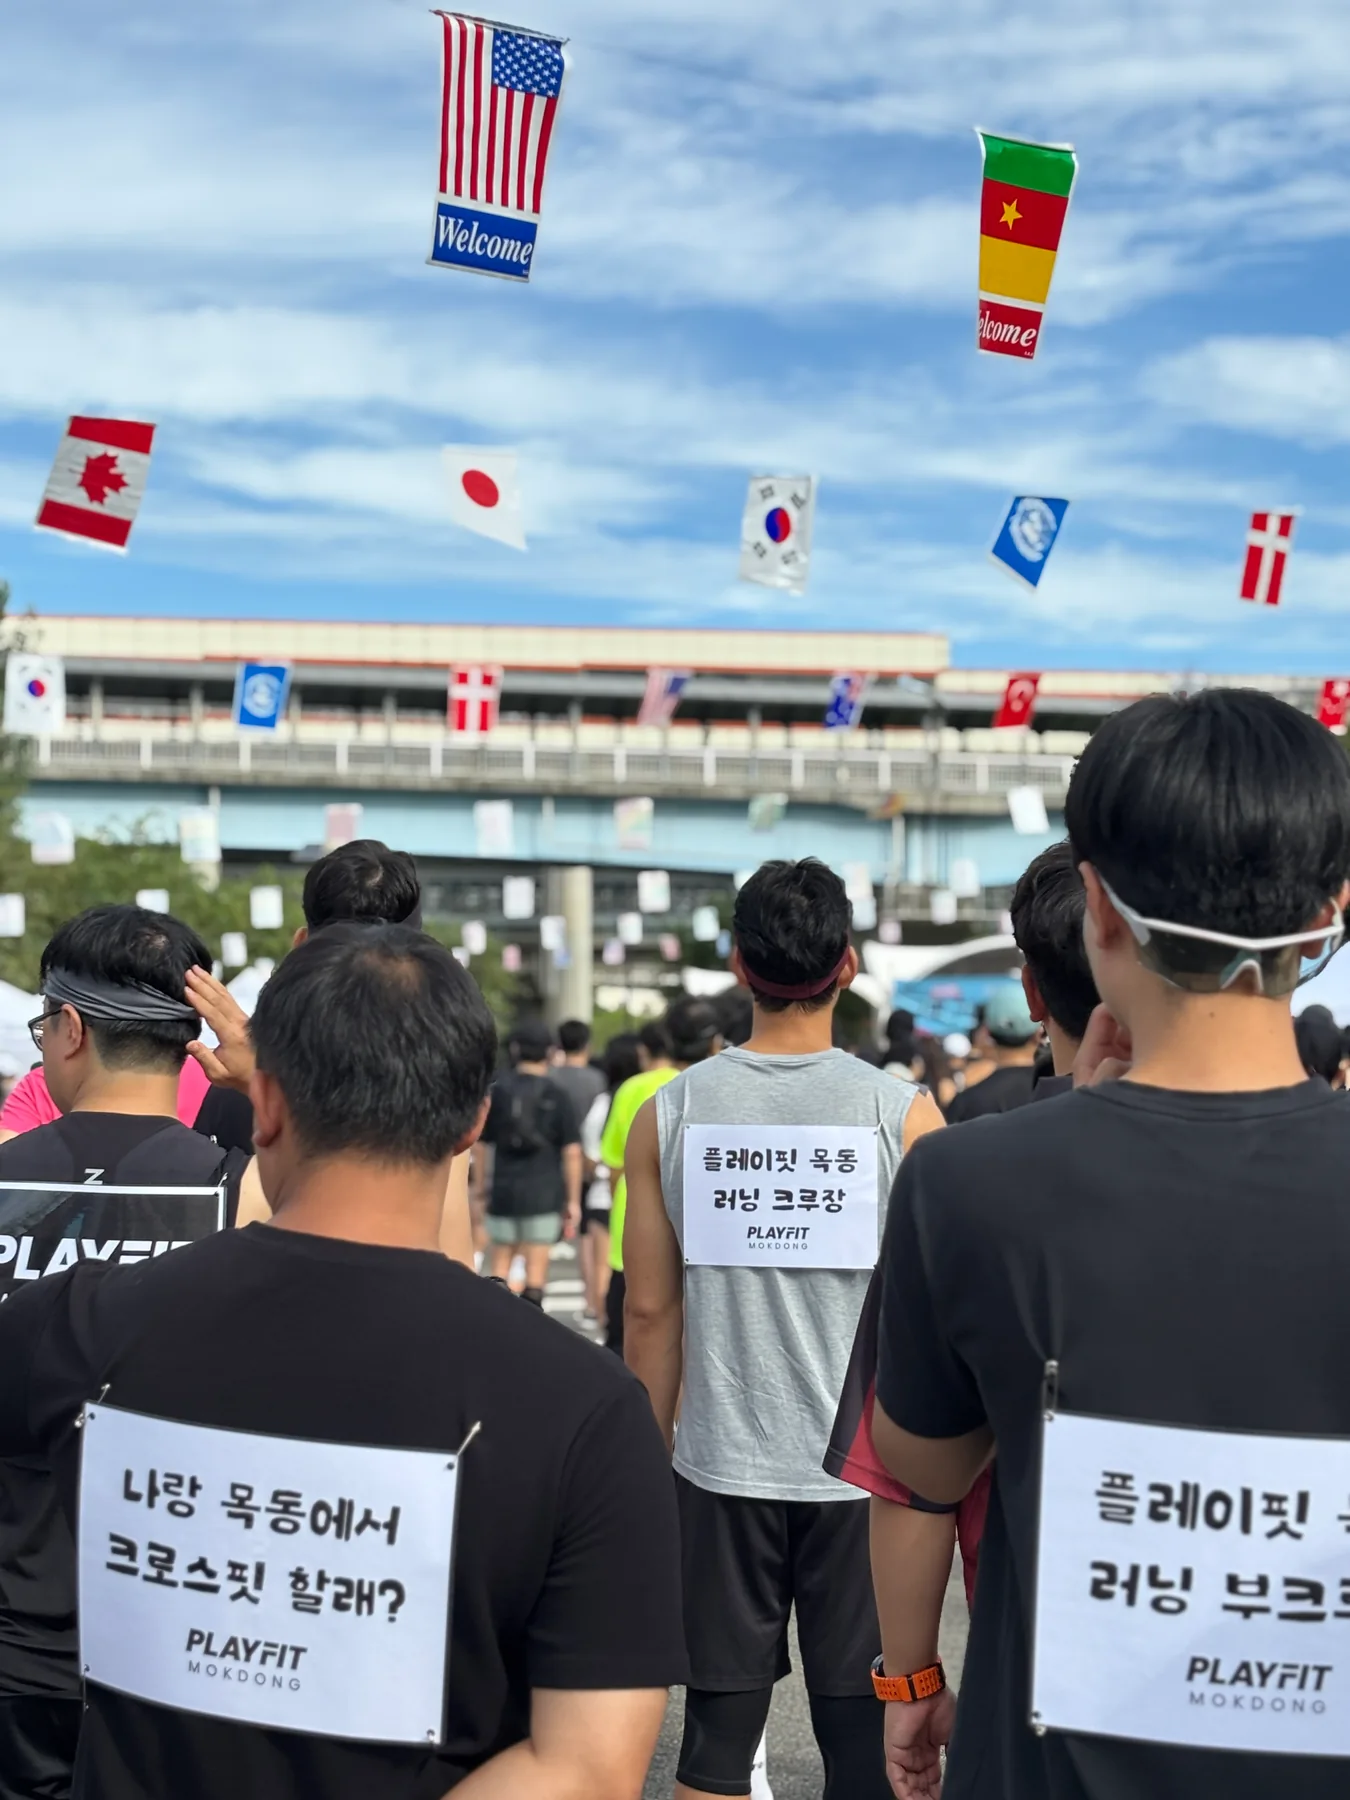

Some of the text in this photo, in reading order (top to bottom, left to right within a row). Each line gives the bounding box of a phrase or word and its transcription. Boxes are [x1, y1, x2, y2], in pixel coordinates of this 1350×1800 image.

[437, 213, 534, 265] Welcome
[979, 309, 1037, 347] elcome
[703, 1147, 858, 1173] 플레이핏 목동
[714, 1188, 846, 1213] 러닝 크루장
[747, 1226, 810, 1240] PLAYFIT
[749, 1242, 808, 1250] MOKDONG
[123, 1468, 401, 1546] 나랑 목동에서
[1094, 1470, 1310, 1541] 플레이핏
[105, 1531, 406, 1623] 크로스핏 할래?
[1089, 1560, 1193, 1616] 러닝
[185, 1627, 308, 1671] PLAYFIT
[188, 1659, 301, 1692] MOKDONG
[1185, 1656, 1333, 1692] PLAYFIT
[1188, 1691, 1327, 1715] MOKDONG
